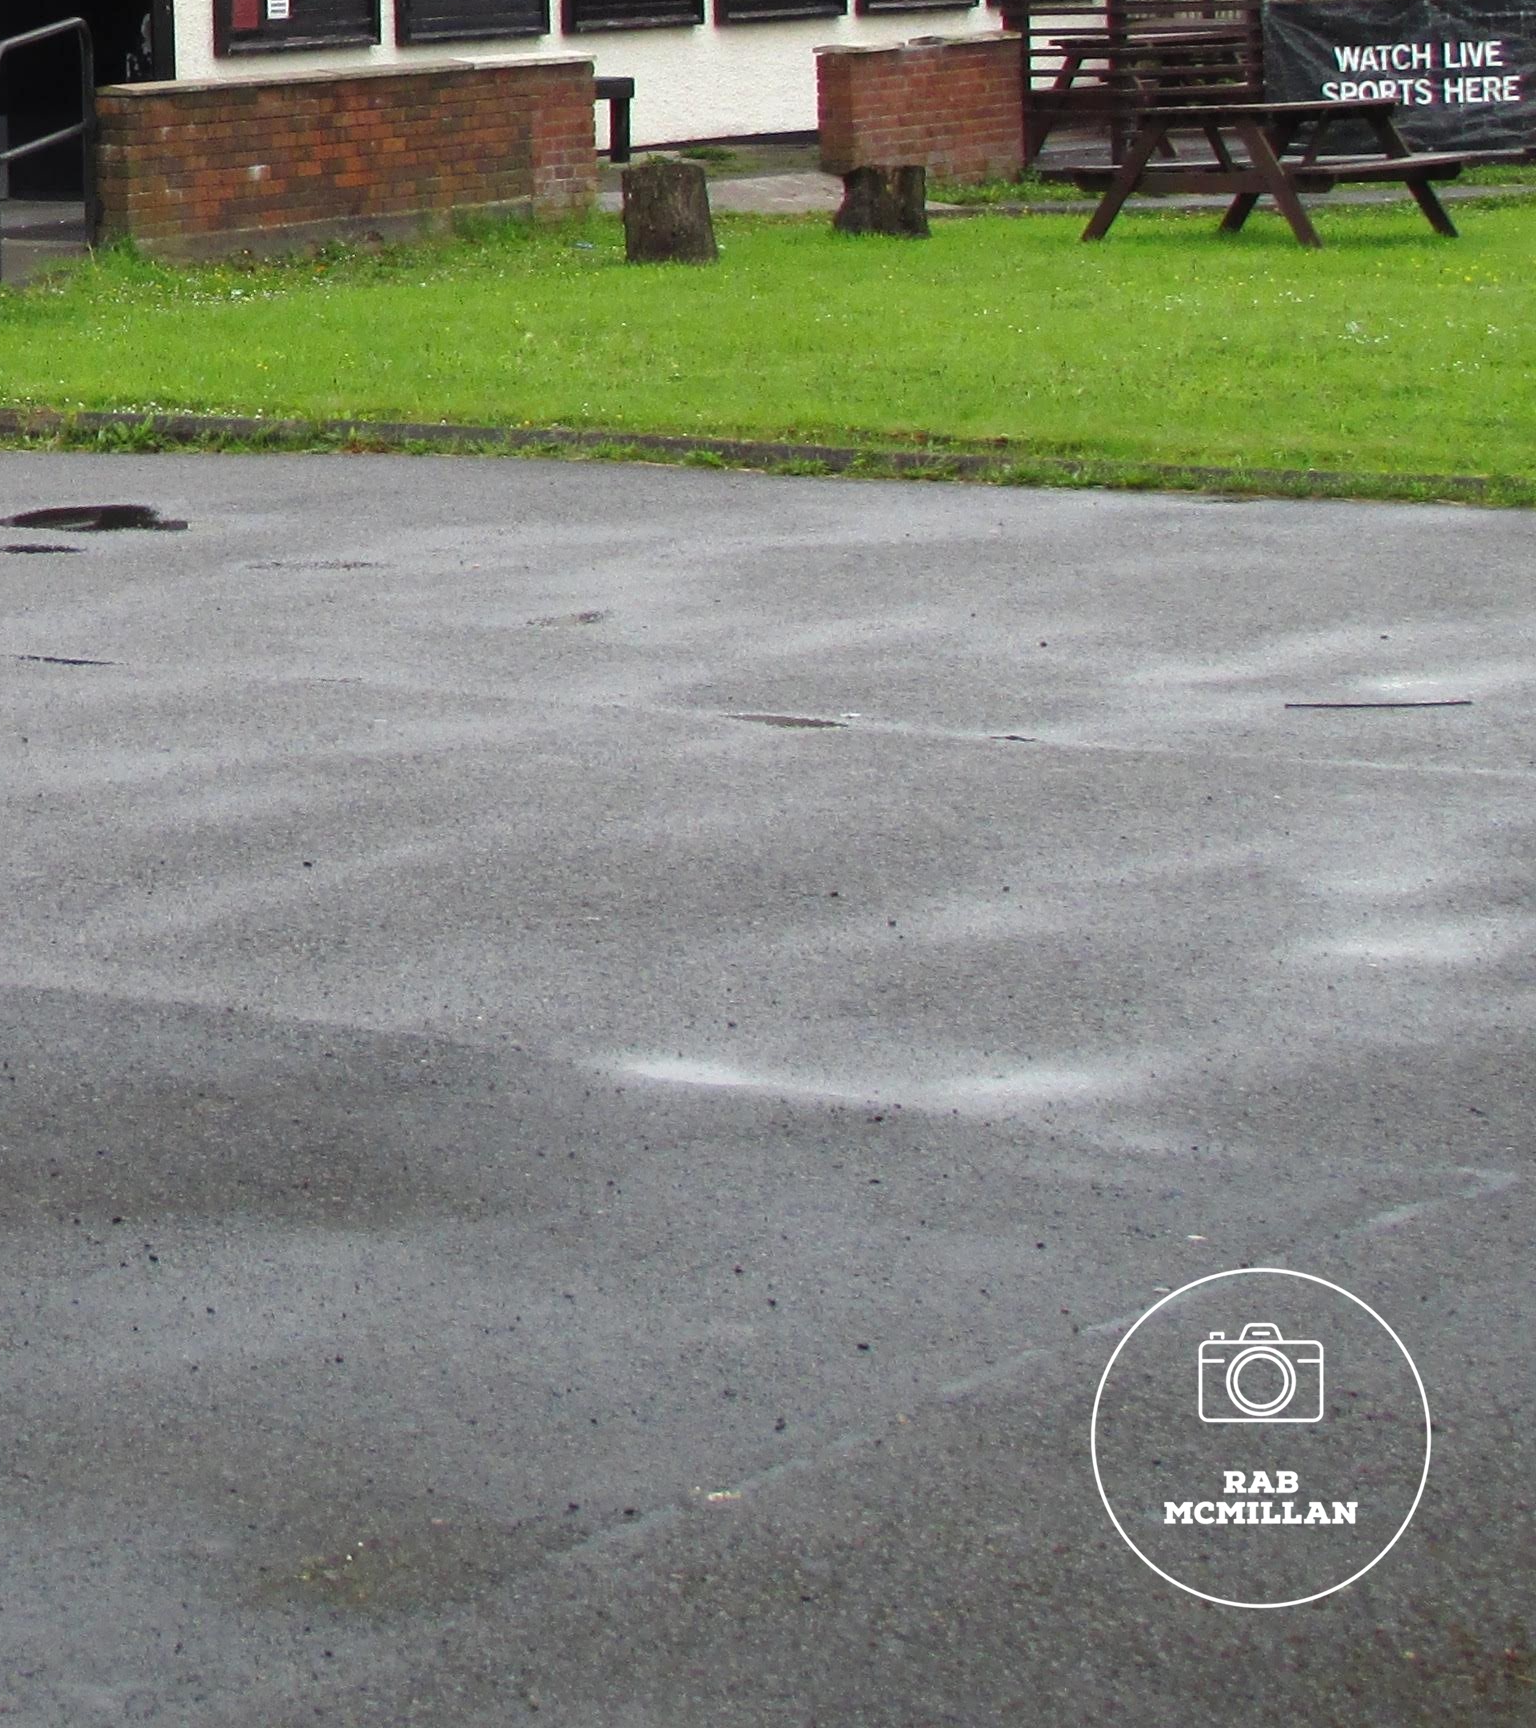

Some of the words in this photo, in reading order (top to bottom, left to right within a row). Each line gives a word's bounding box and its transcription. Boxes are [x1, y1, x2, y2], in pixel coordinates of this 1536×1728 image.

[1333, 42, 1431, 73] WATCH
[1443, 40, 1504, 69] LIVE
[1322, 79, 1433, 106] SPORTS
[1444, 75, 1521, 104] HERE
